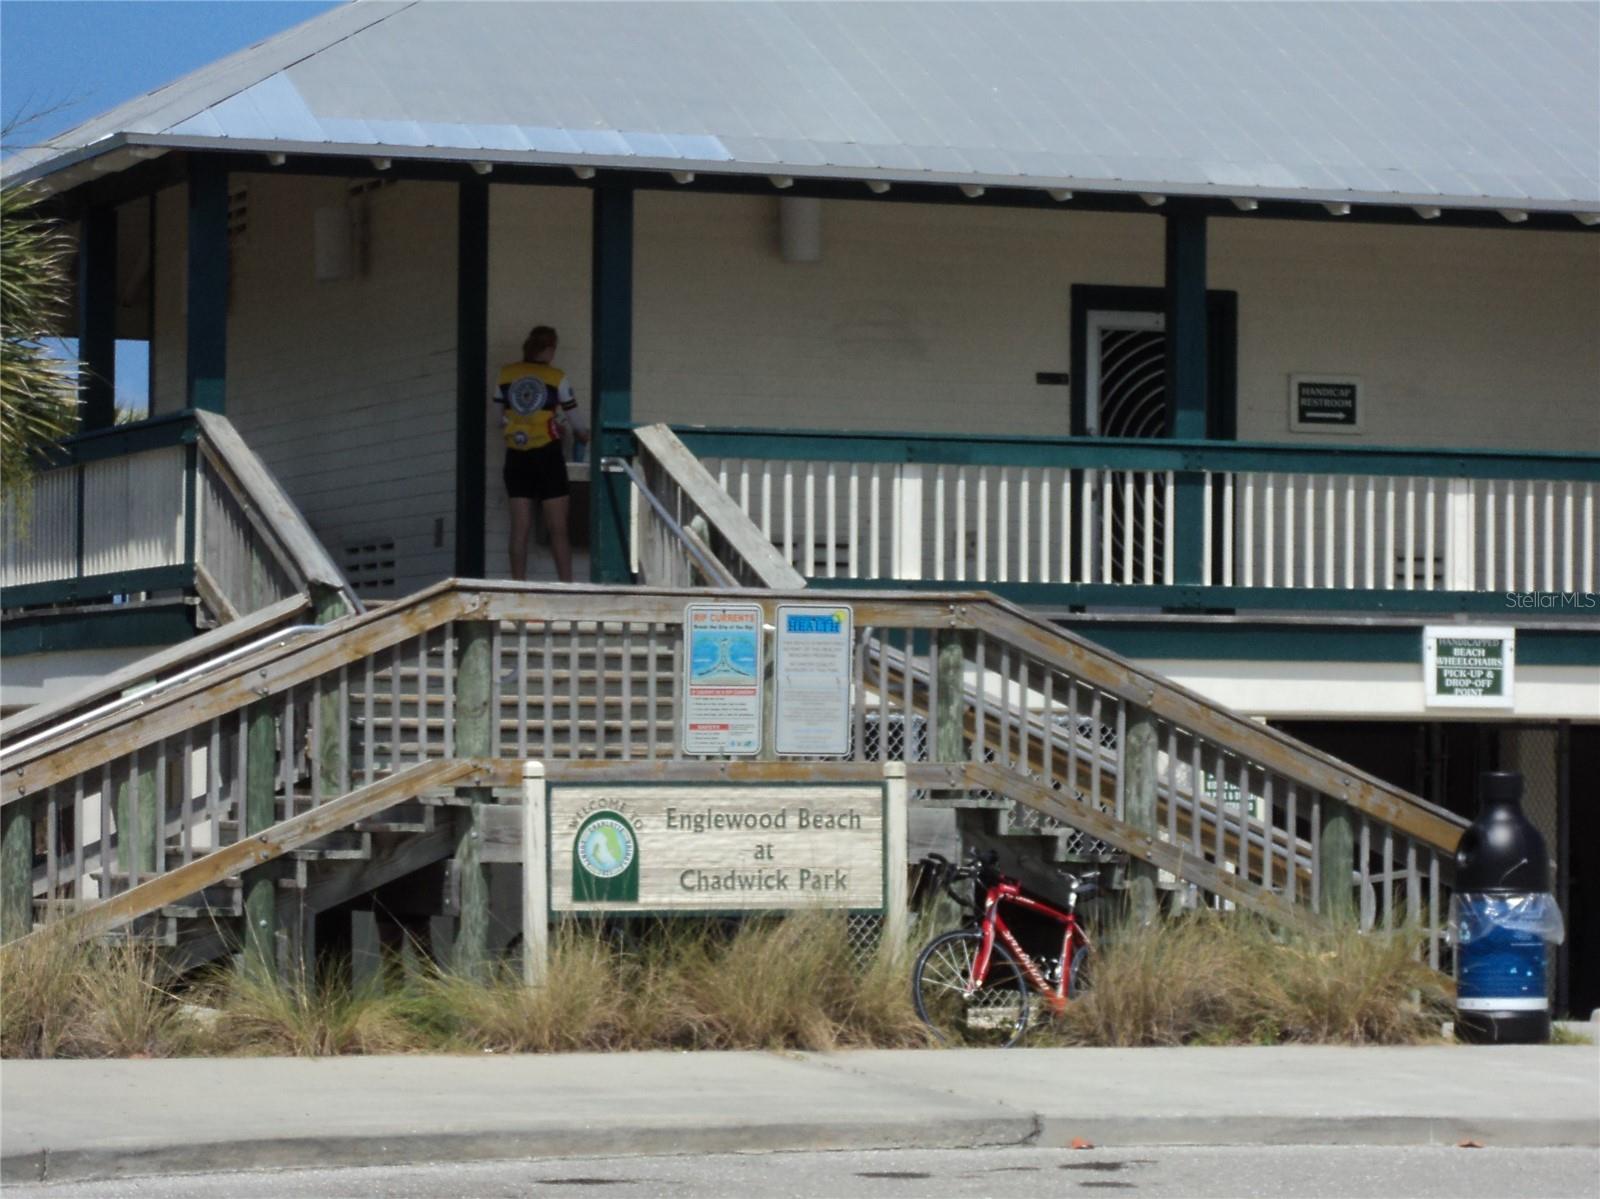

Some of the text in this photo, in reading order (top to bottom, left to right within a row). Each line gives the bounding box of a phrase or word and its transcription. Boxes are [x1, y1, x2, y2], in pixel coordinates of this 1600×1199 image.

[1301, 387, 1352, 397] HANDICAP
[1301, 398, 1352, 408] RESTROOM
[1439, 638, 1500, 647] HANDICAPPED
[1453, 648, 1486, 657] BEACH
[1437, 657, 1503, 667] WHEELCHAIRS
[1443, 669, 1495, 679] PICK-UP &
[1445, 678, 1493, 687] DROP-OFF
[1454, 688, 1484, 696] POINT
[568, 798, 644, 830] WELCOME TO
[666, 808, 861, 831] Englewood Beach
[753, 843, 773, 861] at
[680, 868, 847, 892] Chadwick Park
